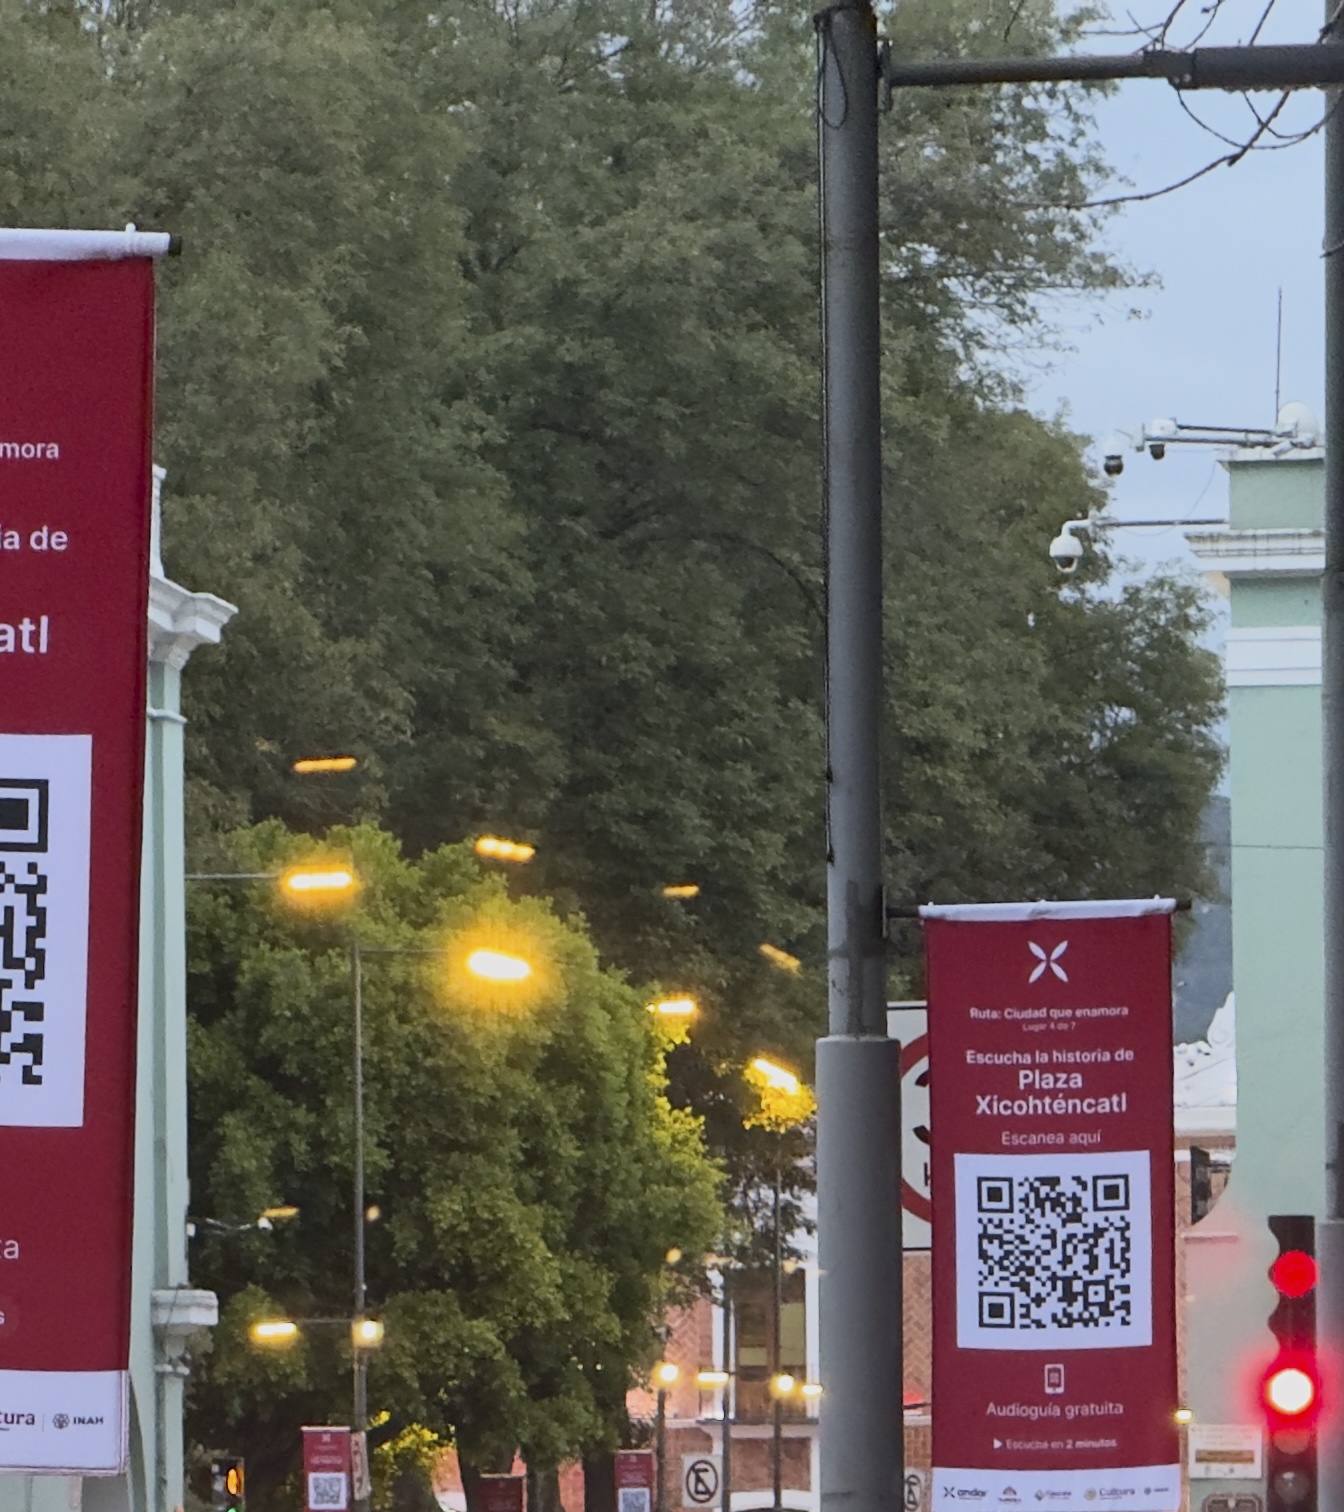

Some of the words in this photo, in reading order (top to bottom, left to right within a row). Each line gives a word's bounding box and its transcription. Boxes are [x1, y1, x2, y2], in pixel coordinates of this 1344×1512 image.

[30, 526, 67, 550] de
[970, 1008, 1000, 1019] Ruta:
[1004, 1007, 1047, 1019] Ciudad
[1049, 1008, 1072, 1020] que
[1075, 1007, 1128, 1017] enamora
[966, 1050, 1031, 1064] Escucha
[1036, 1050, 1048, 1063] la
[1053, 1049, 1110, 1063] historia
[1115, 1048, 1134, 1061] de
[1019, 1069, 1082, 1090] Plaza
[976, 1093, 1126, 1115] Xicohténcatl
[1002, 1131, 1064, 1145] Escanea
[1069, 1130, 1101, 1146] aquí
[987, 1402, 1060, 1420] Audioguía
[1065, 1402, 1123, 1419] gratuita
[1066, 1440, 1072, 1449] 2
[1075, 1439, 1117, 1448] minutos
